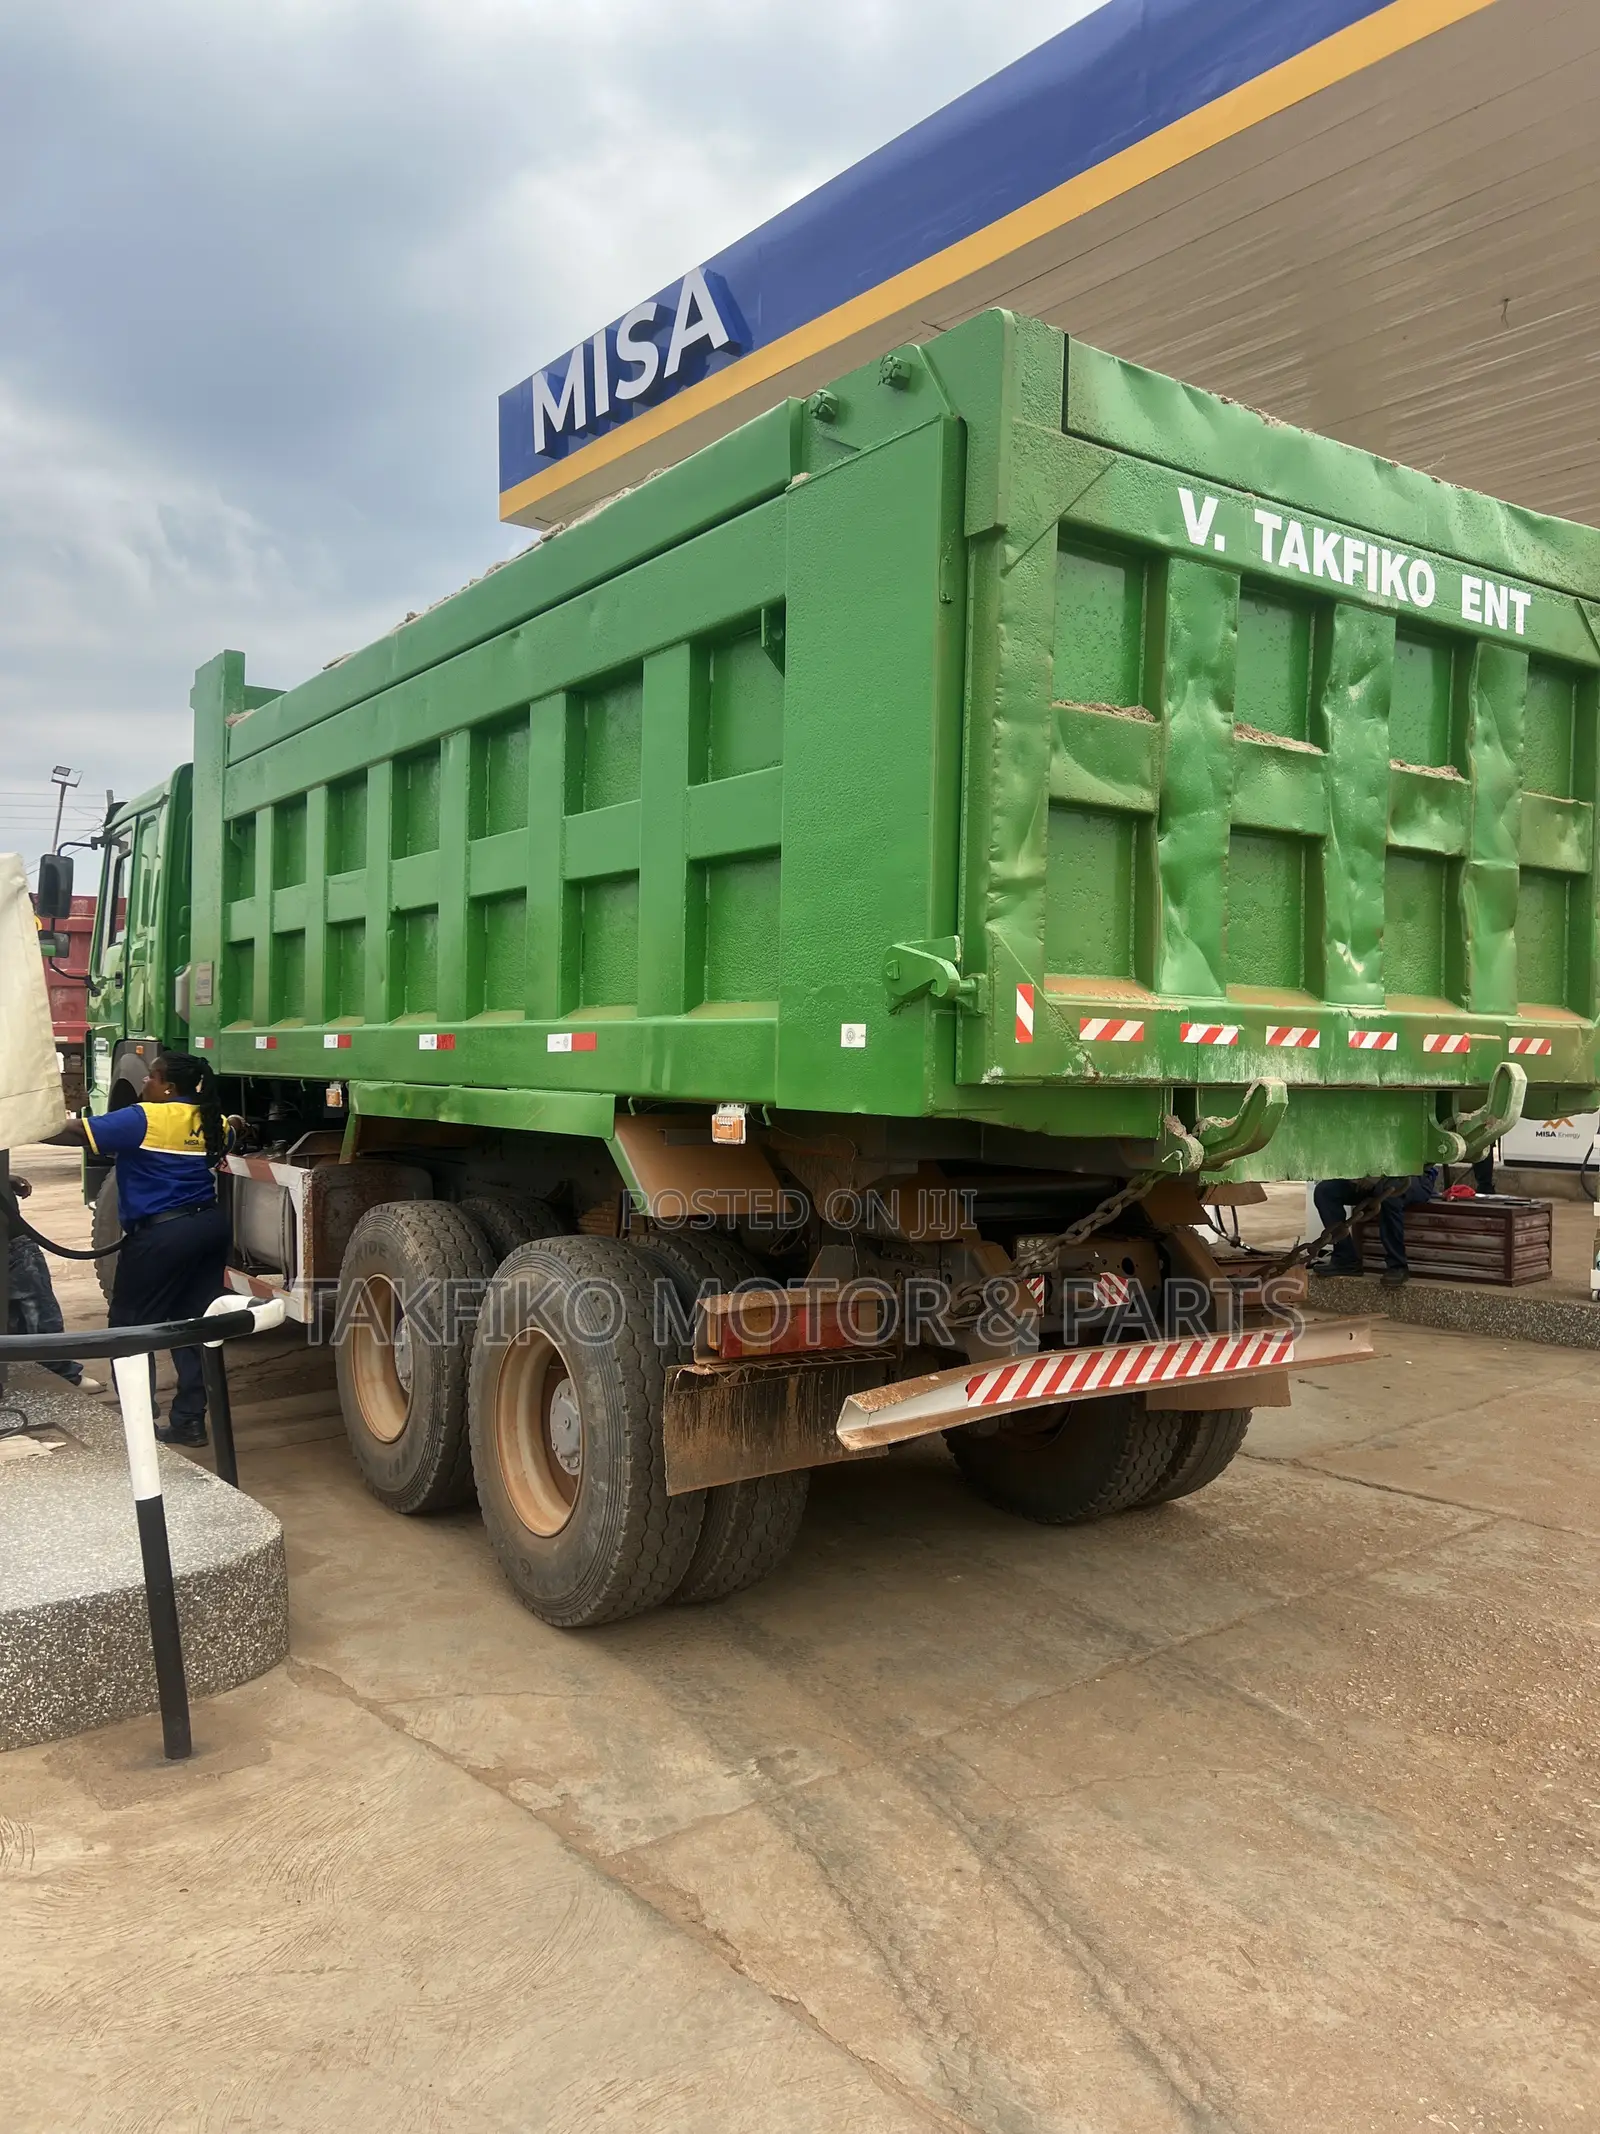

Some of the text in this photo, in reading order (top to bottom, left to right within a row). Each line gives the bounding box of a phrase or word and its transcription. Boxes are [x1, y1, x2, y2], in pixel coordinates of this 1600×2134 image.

[532, 267, 730, 455] MISA
[1178, 488, 1531, 636] V. TAKFIKO ENT
[1558, 1132, 1581, 1140] Energy
